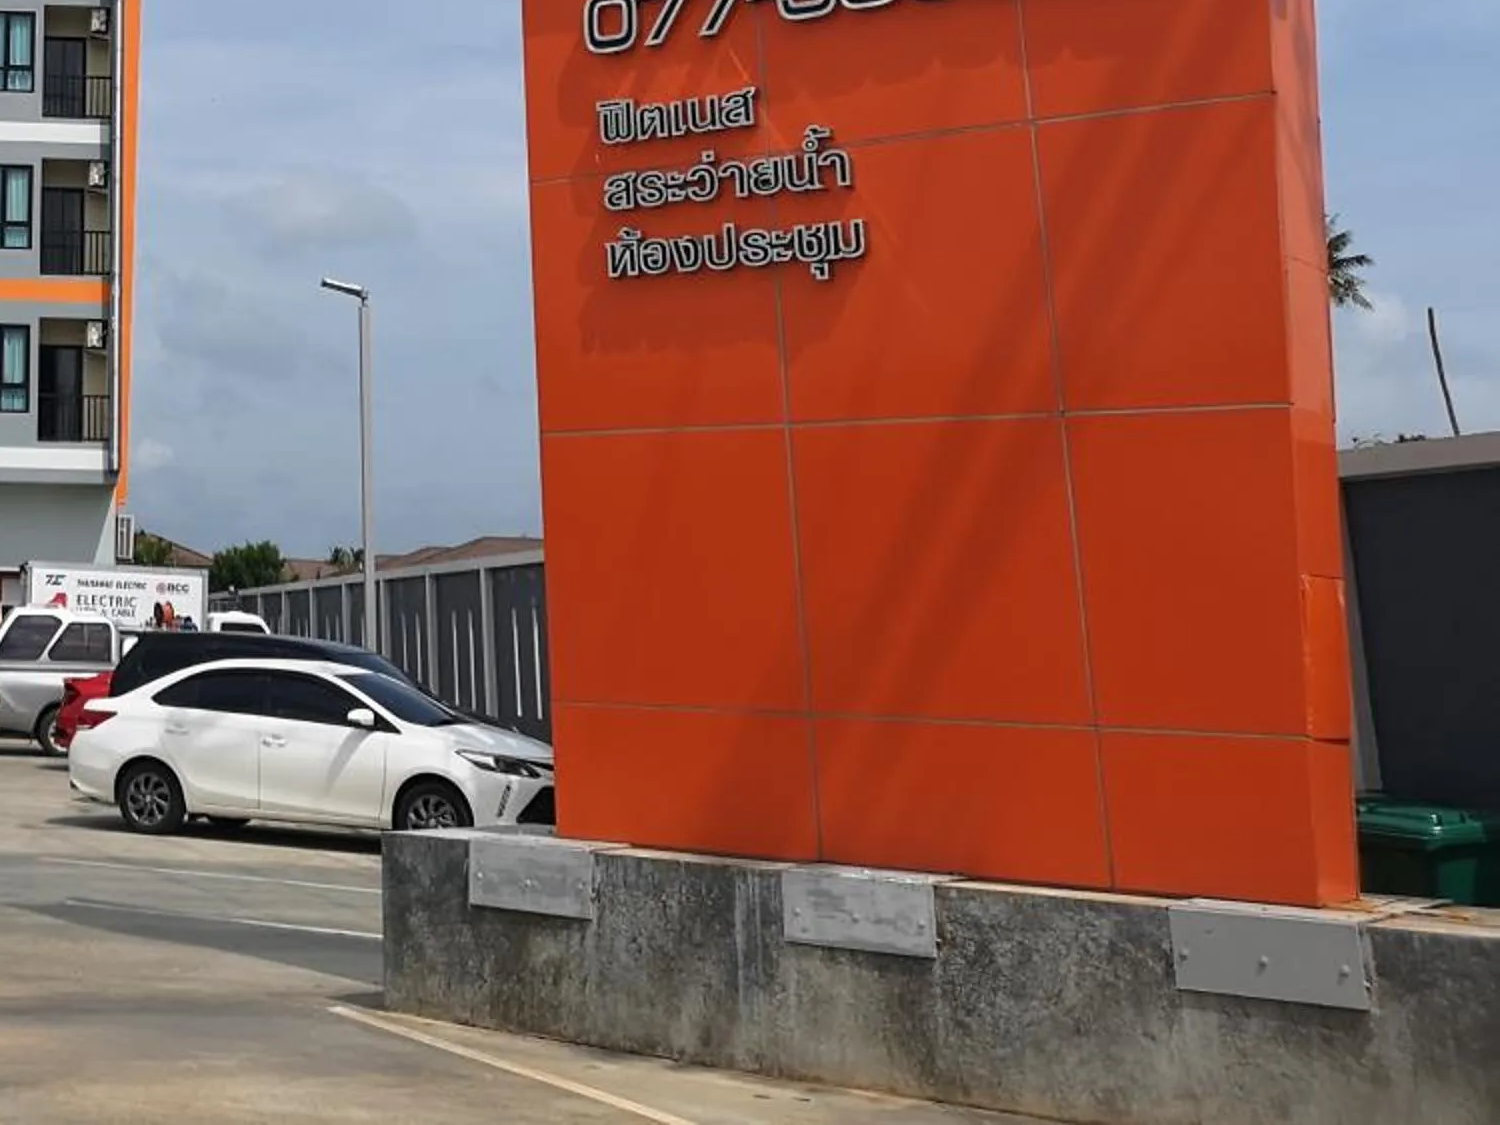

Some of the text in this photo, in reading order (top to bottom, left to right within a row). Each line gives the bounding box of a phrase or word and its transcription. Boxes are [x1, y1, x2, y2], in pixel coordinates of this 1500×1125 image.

[596, 86, 756, 144] ฟิตเนส
[604, 124, 852, 210] สระว่ายน้ำ
[606, 219, 865, 280] ห้องประชุม
[77, 594, 138, 608] ELECTRIC
